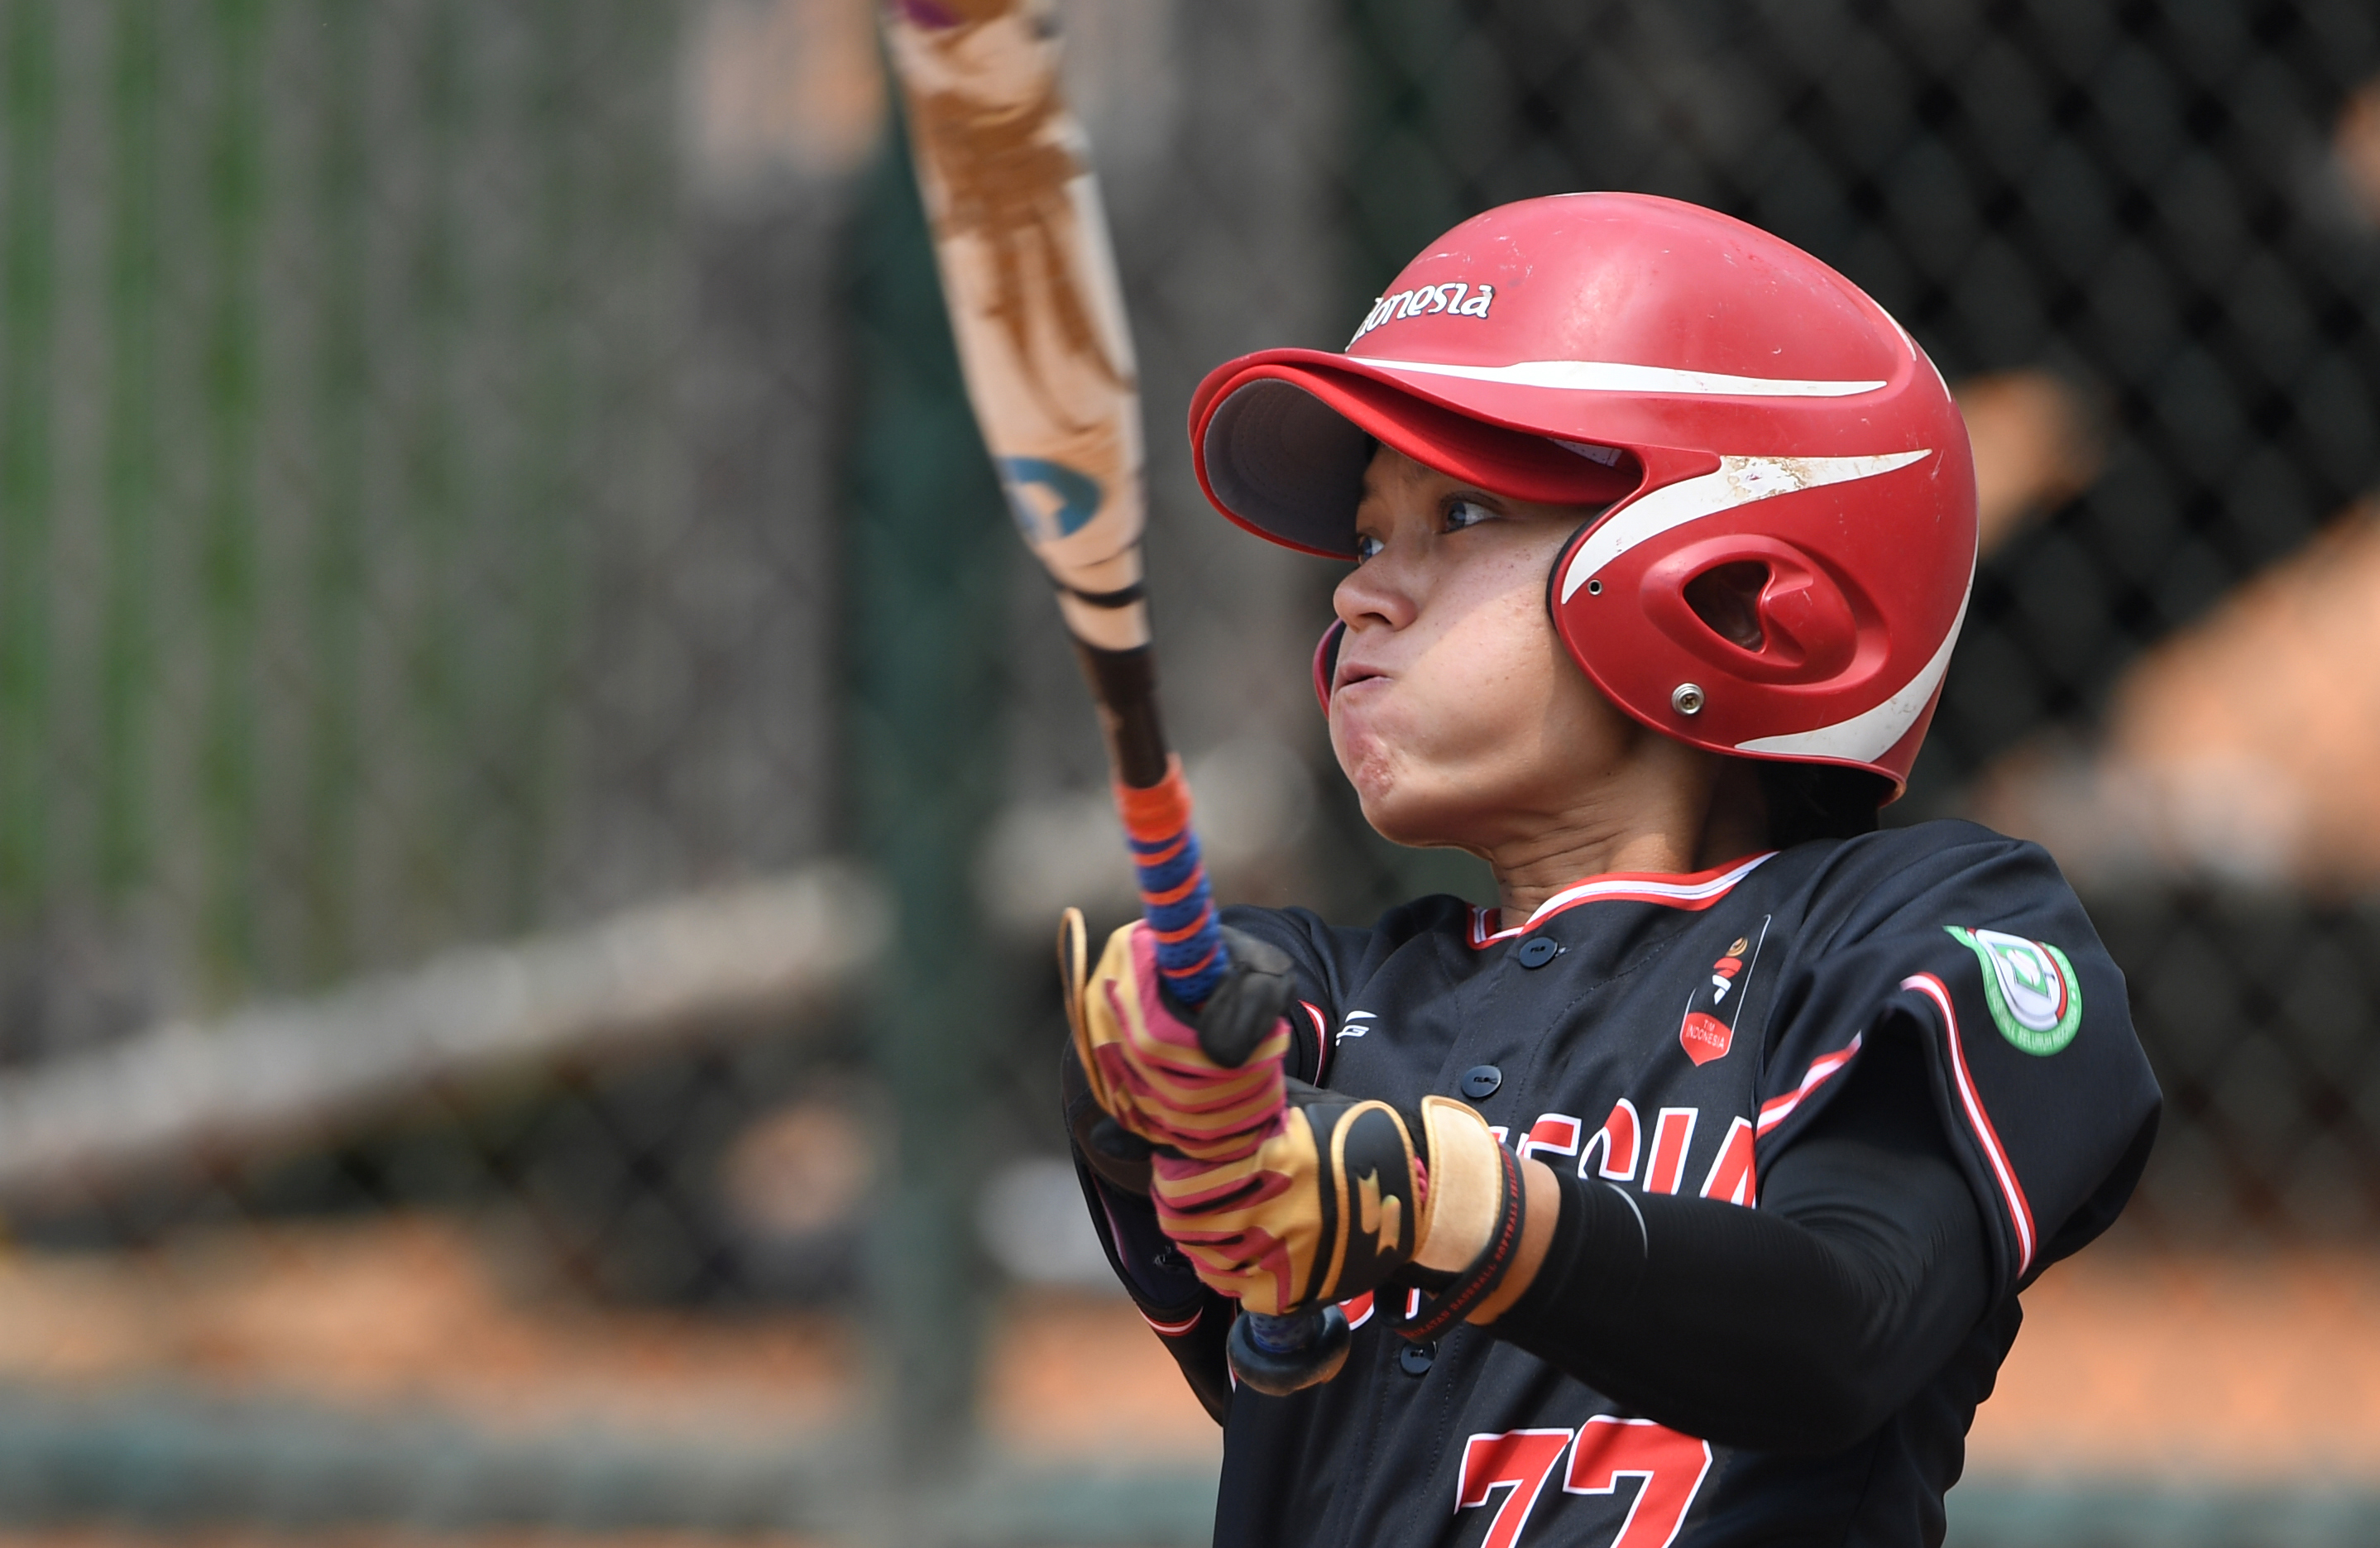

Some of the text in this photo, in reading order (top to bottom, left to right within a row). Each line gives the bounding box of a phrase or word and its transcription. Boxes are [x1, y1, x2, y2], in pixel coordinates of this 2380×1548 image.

[1685, 1023, 1726, 1051] INDONESIA
[1704, 1018, 1717, 1033] TIM
[1453, 1414, 1713, 1548] 77
